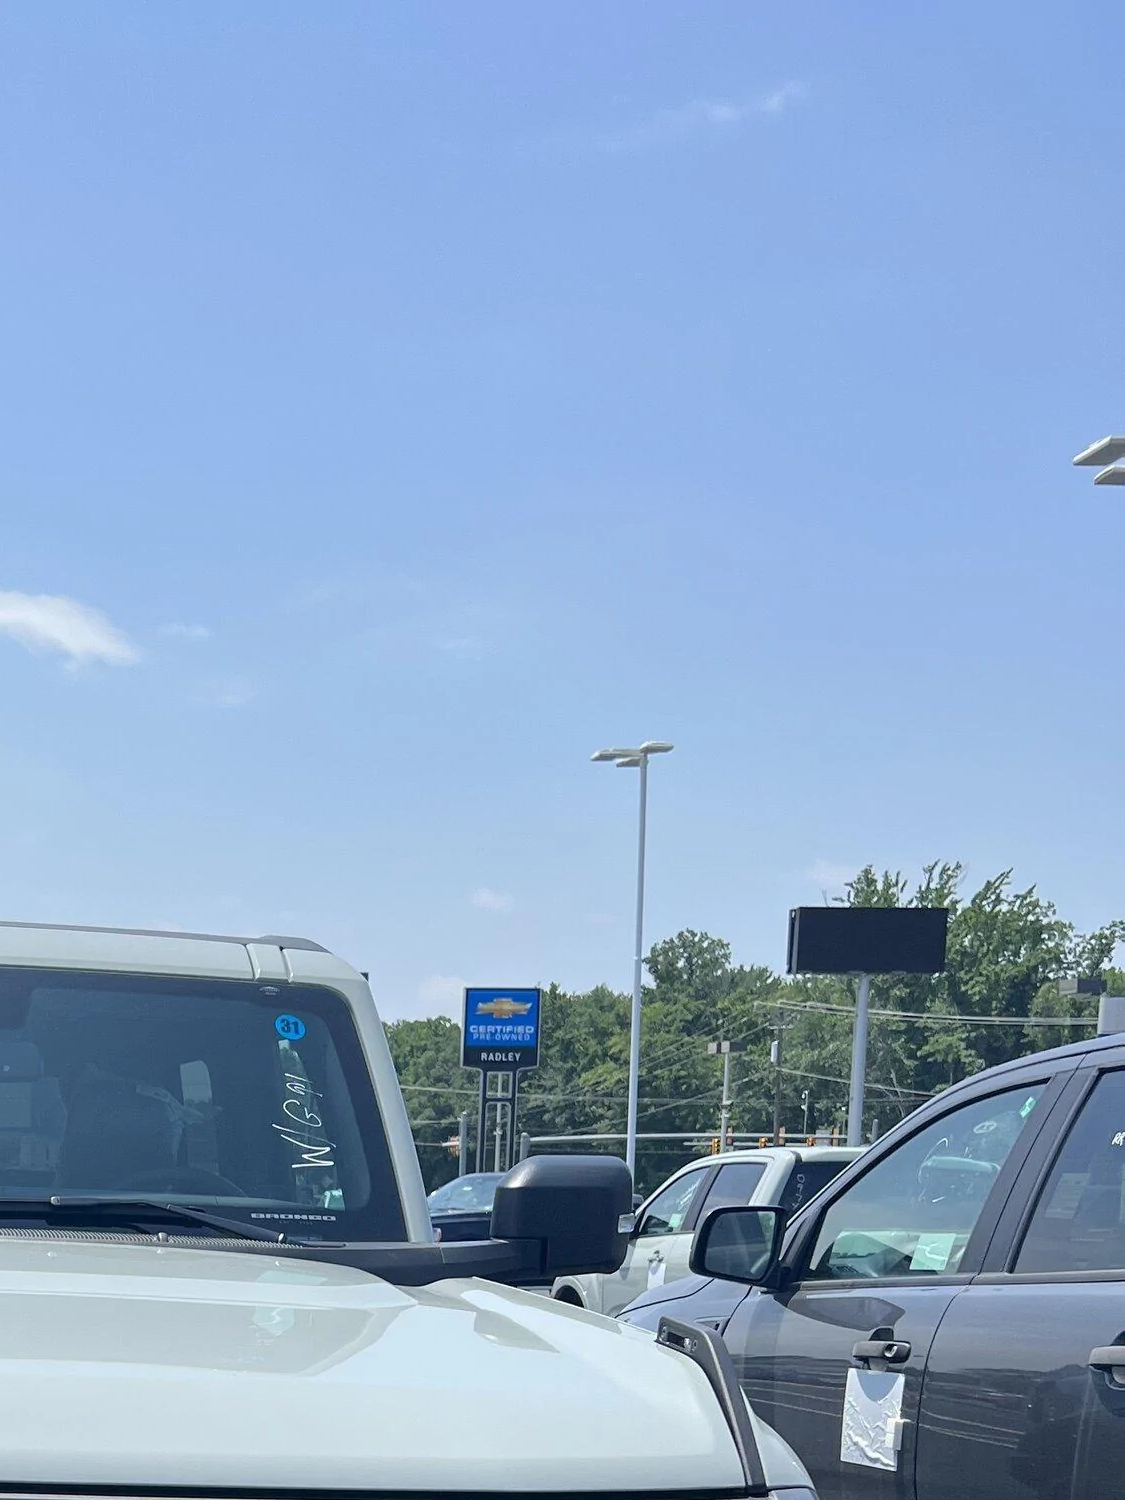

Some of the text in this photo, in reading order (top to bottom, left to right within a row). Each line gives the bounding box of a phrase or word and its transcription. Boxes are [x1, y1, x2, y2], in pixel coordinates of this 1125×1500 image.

[469, 1025, 535, 1034] CERTIFIED
[472, 1033, 531, 1041] PRE-OWNED
[480, 1052, 521, 1061] RADLEY
[250, 1212, 337, 1221] BRONCO
